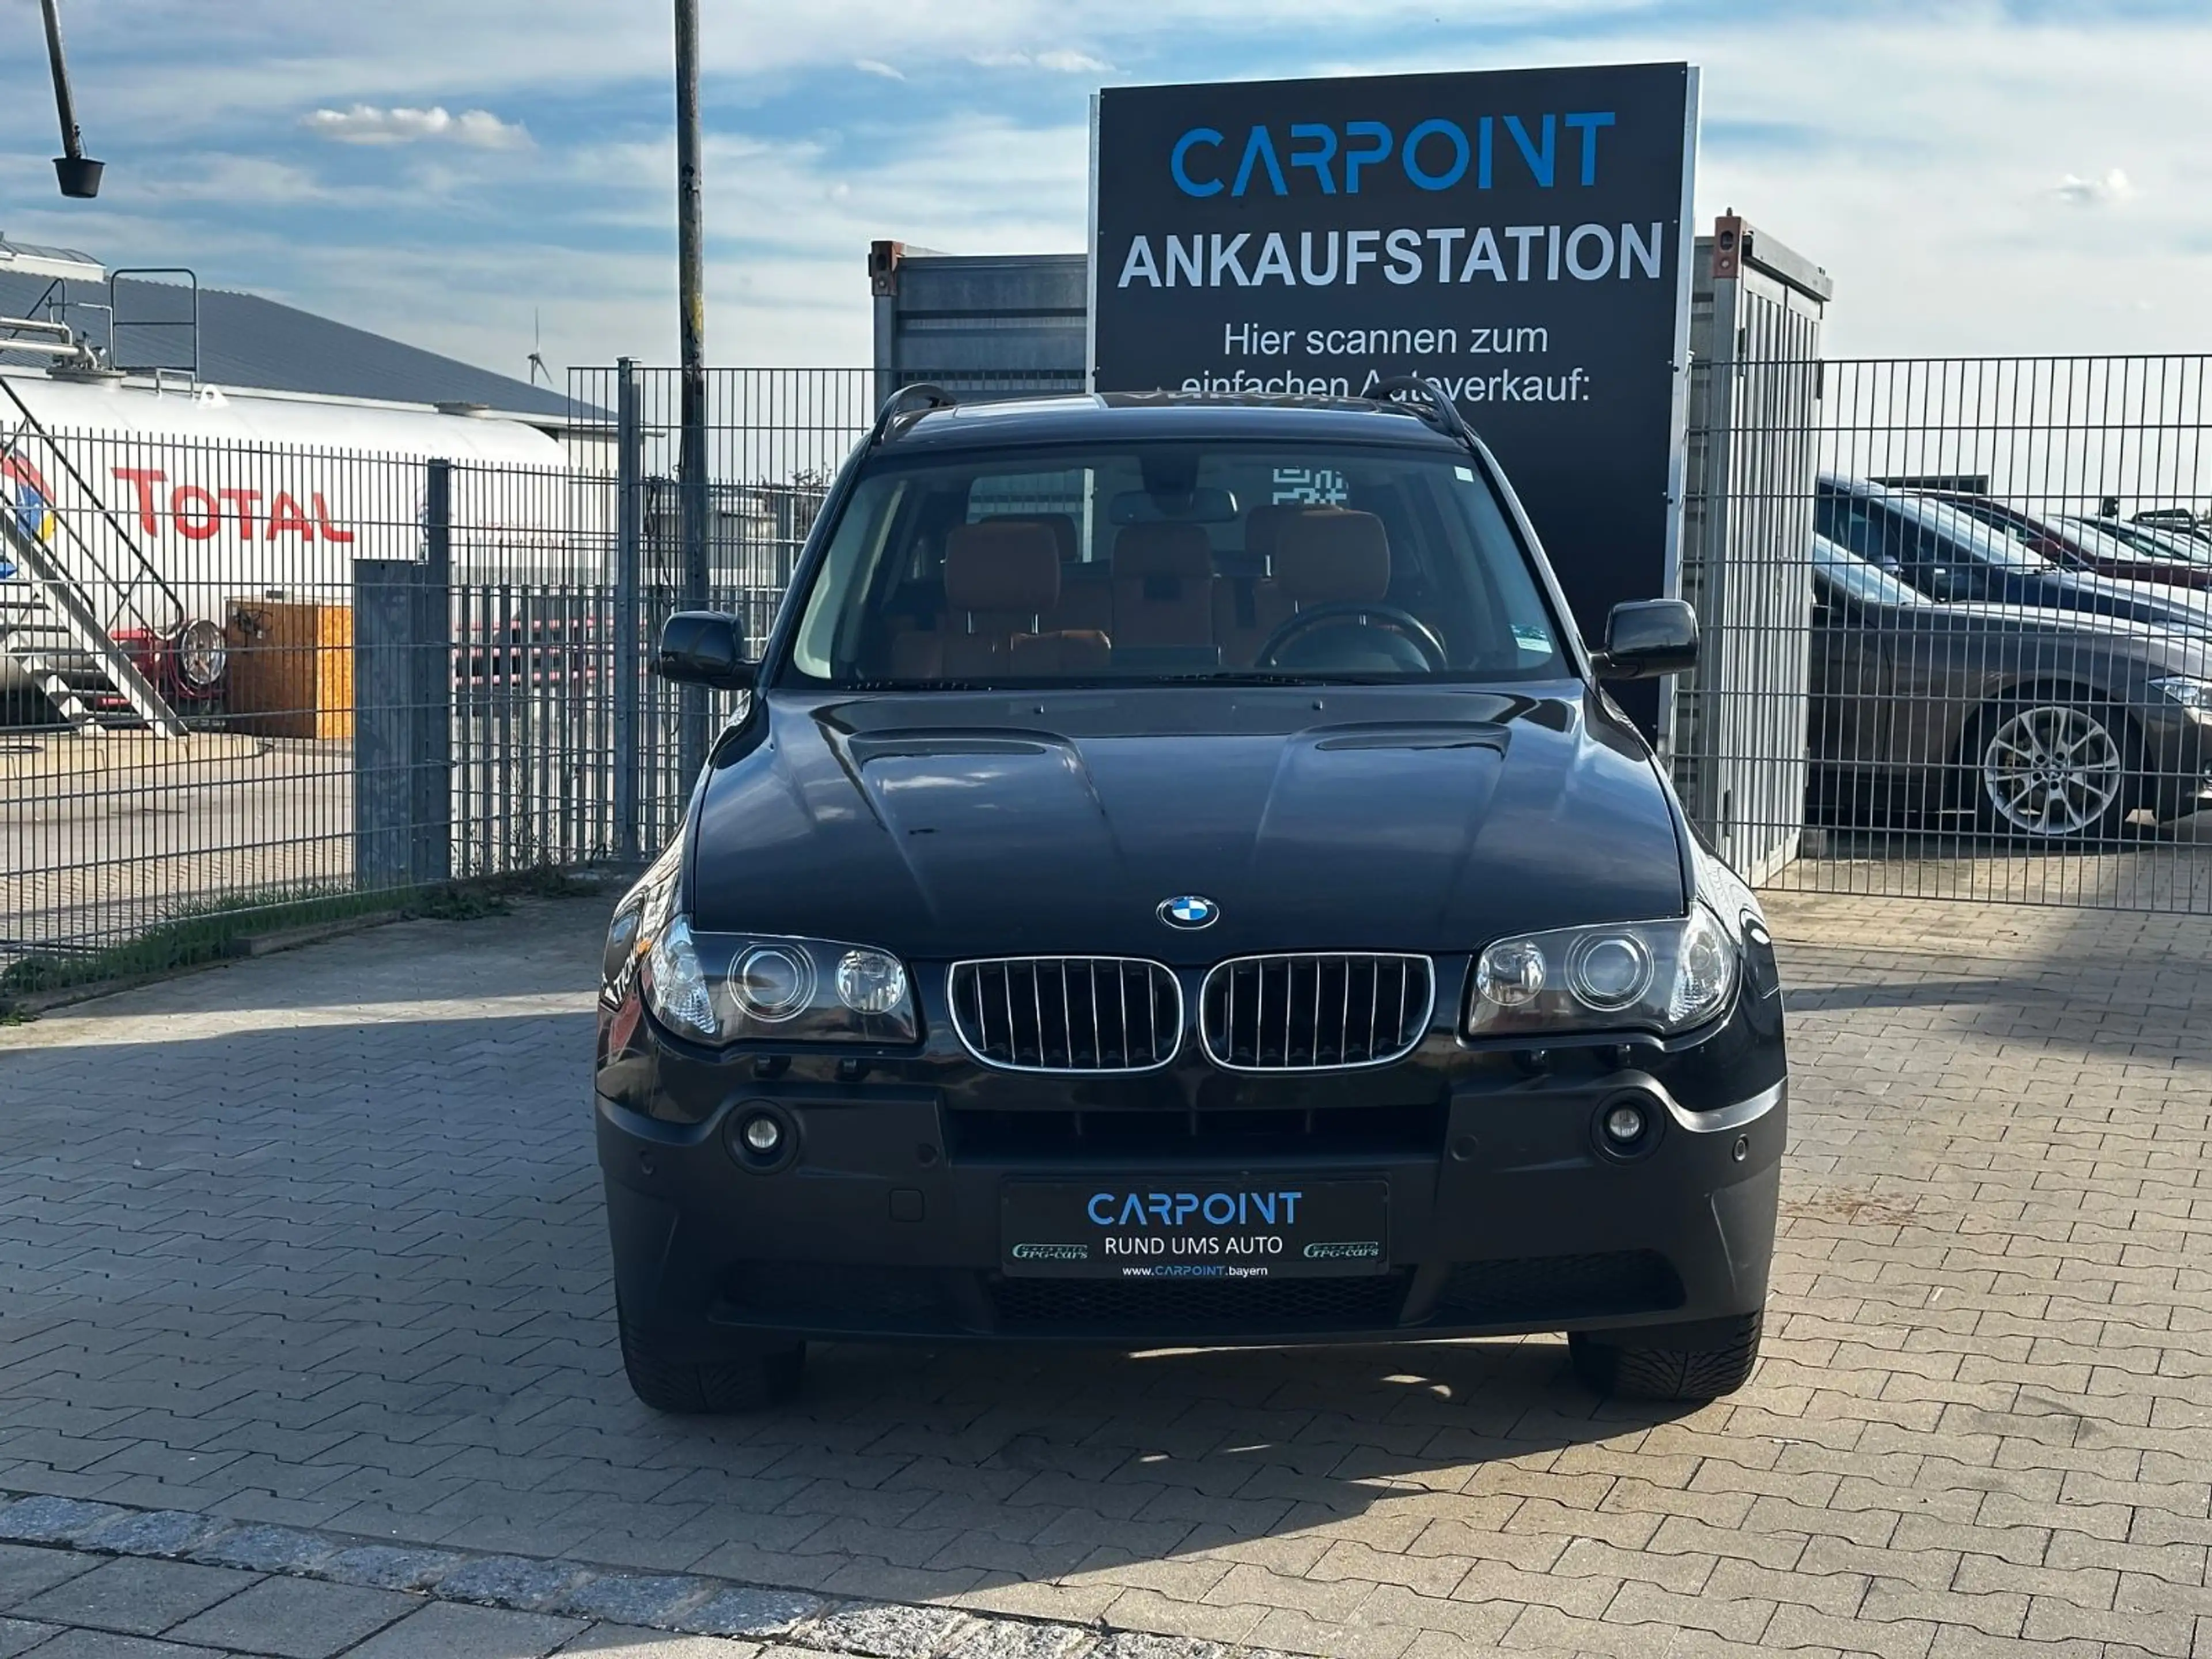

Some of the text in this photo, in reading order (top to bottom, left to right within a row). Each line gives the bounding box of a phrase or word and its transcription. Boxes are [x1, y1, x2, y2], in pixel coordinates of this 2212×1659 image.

[1170, 111, 1616, 199] CARPOINT
[1118, 223, 1662, 287] ANKAUFSTATION
[1225, 323, 1548, 355] Hier scannen zum
[1181, 369, 1349, 397] einfachen
[111, 467, 354, 542] TOTAL
[1088, 1192, 1302, 1225] CARPOINT
[1105, 1236, 1283, 1255] RUND UMS AUTO
[1122, 1266, 1268, 1278] www.CARPOINT.bayern
